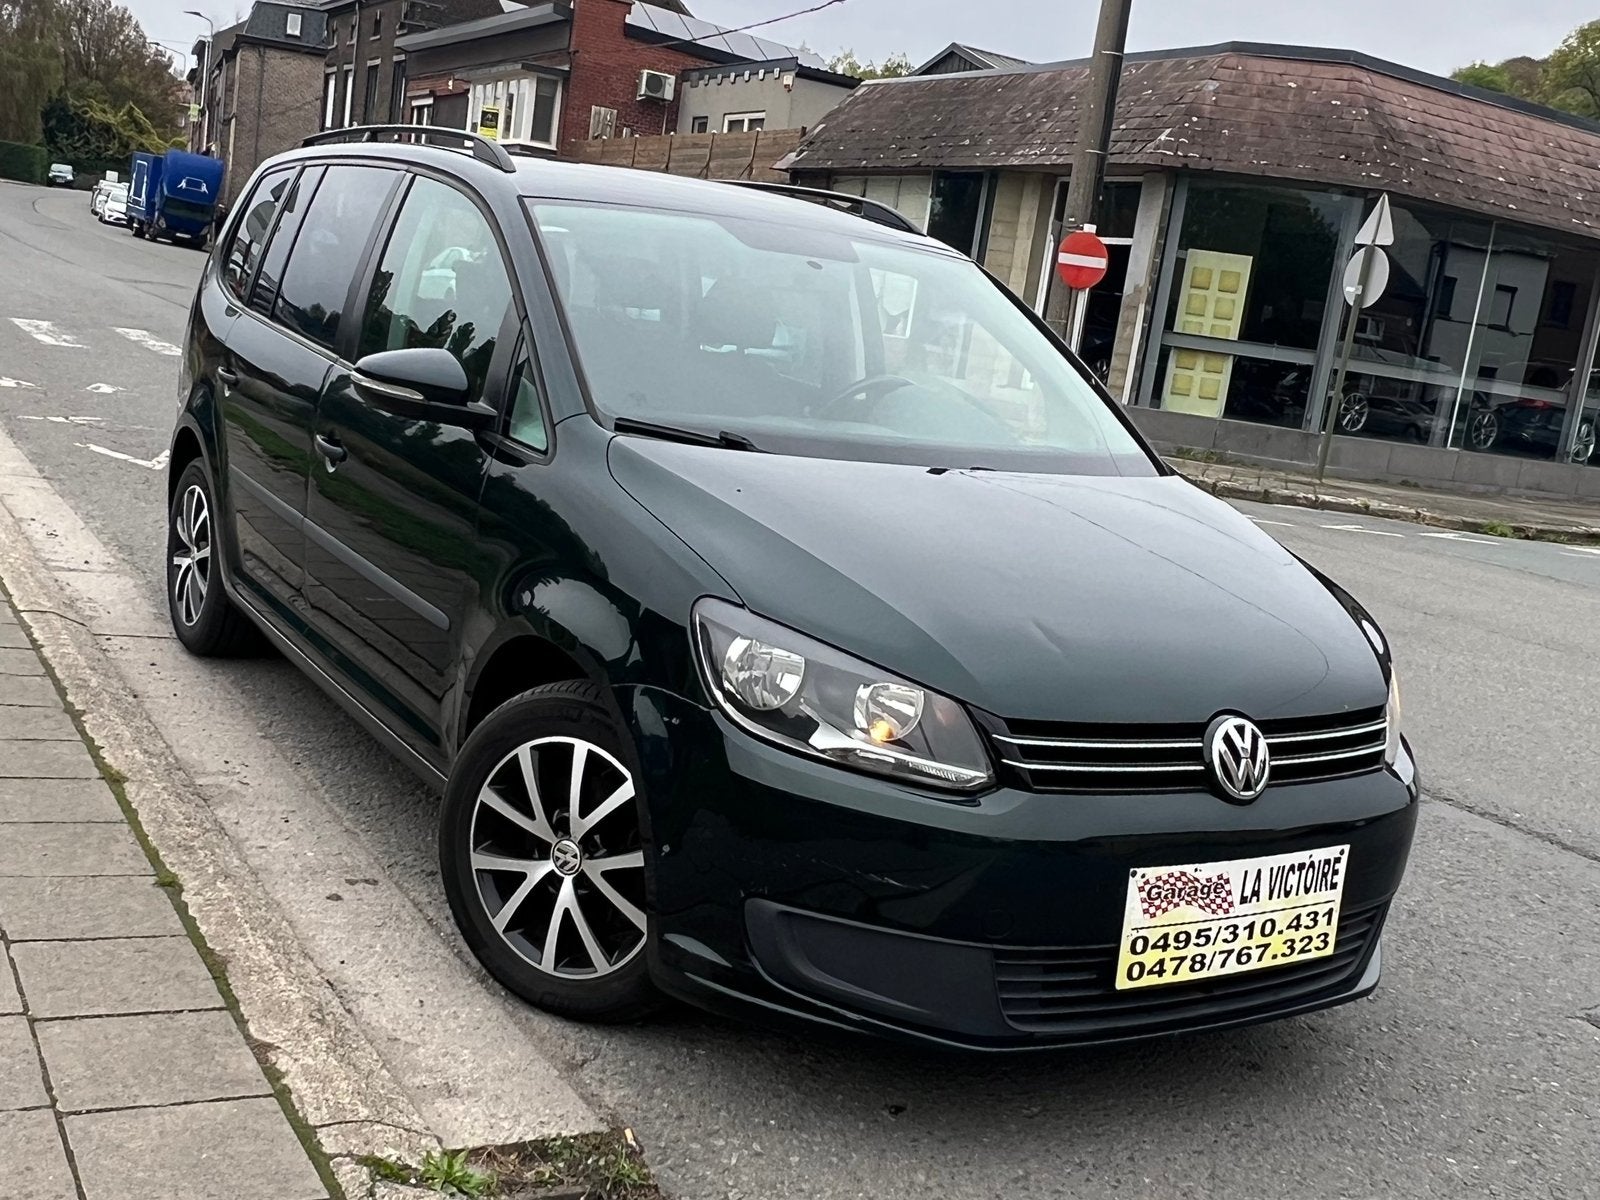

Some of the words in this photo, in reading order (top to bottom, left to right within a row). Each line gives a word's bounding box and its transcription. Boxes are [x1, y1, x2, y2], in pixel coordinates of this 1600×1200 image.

[1146, 881, 1225, 902] Garage
[1239, 869, 1263, 905] LA
[1268, 856, 1342, 899] VICTOIRE
[1129, 907, 1335, 956] 0495/310.431
[1126, 932, 1330, 982] 0478/767.323
